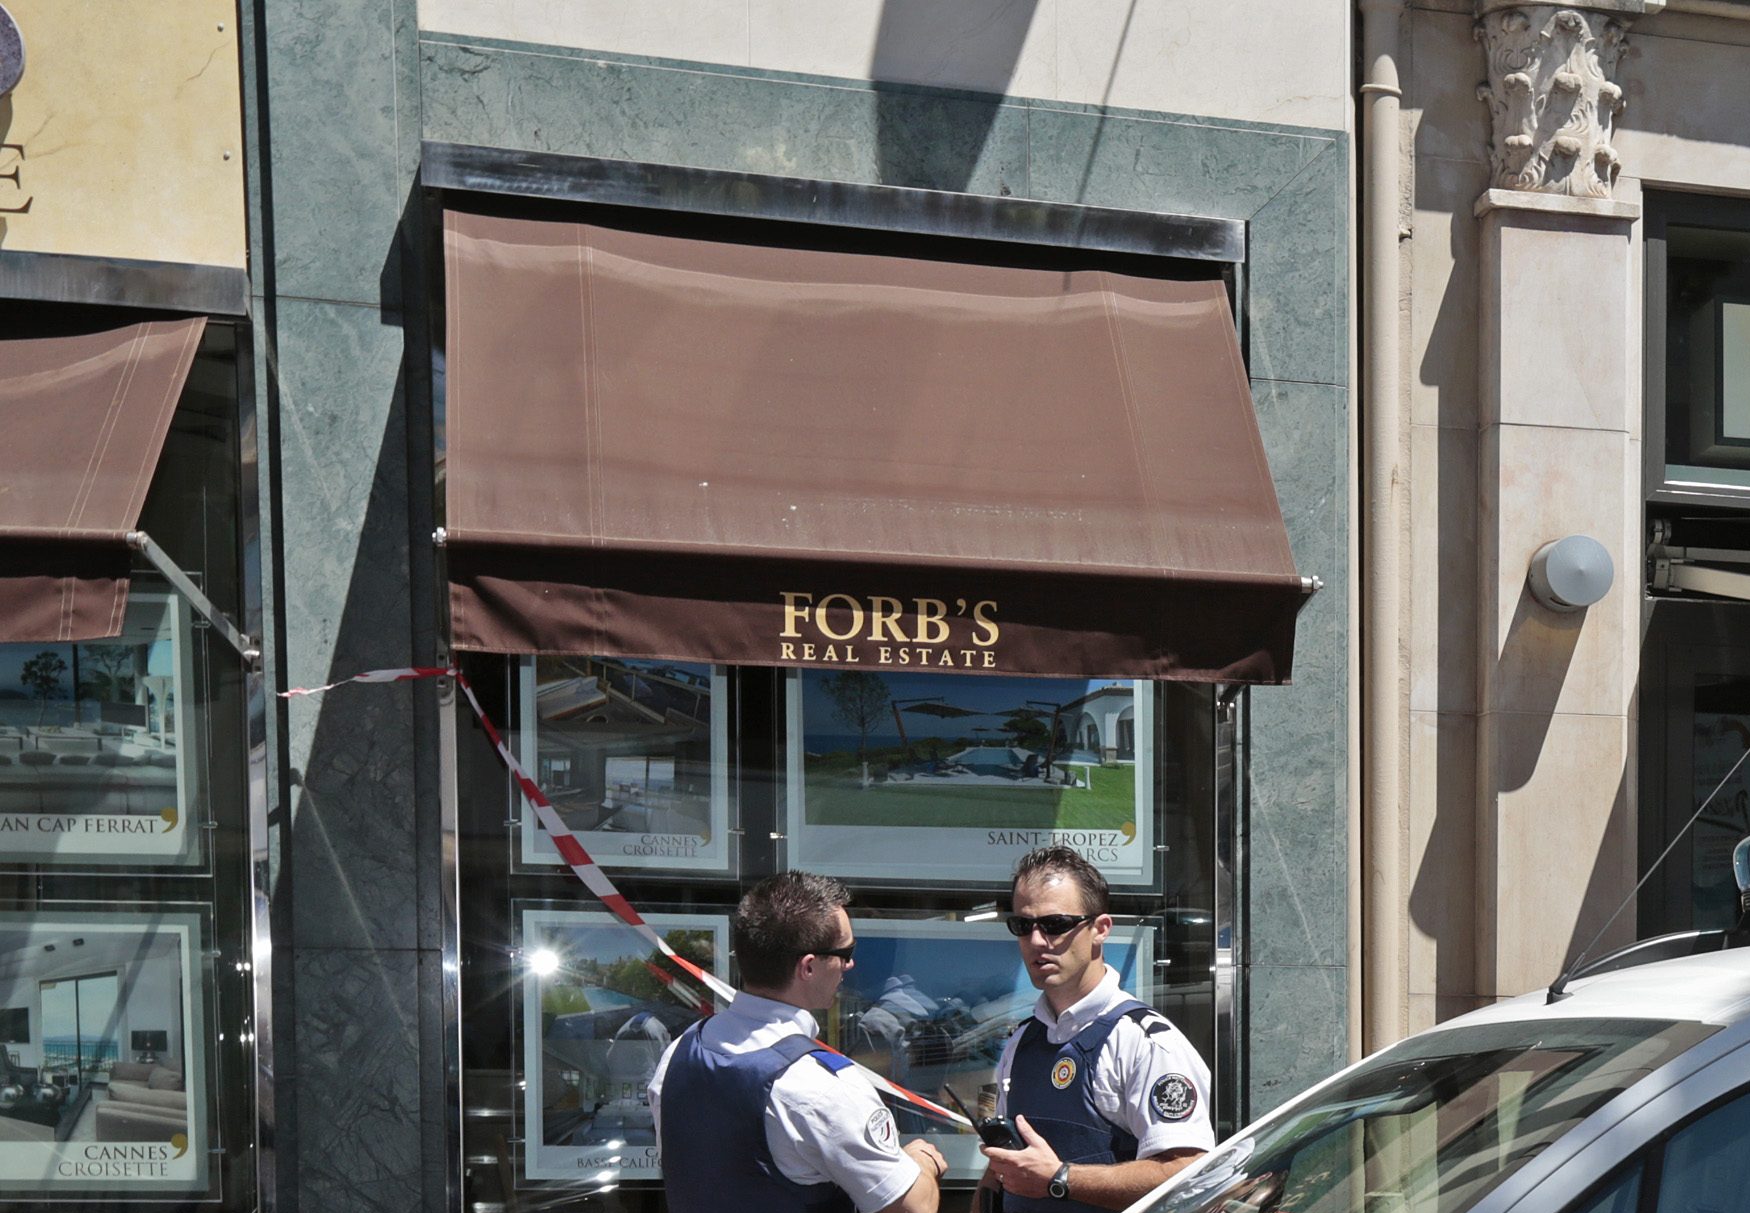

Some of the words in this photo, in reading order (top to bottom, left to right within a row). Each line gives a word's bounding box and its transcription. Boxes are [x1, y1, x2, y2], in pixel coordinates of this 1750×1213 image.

[780, 591, 1000, 646] FORB'S
[780, 642, 860, 663] REAL
[878, 646, 997, 668] ESTATE
[0, 817, 29, 831] AN
[37, 818, 76, 832] CAP
[85, 818, 158, 834] FERRAT
[641, 834, 698, 846] CANNES
[987, 831, 1118, 847] SAINT-TROPEZ
[622, 844, 697, 857] CROISETTE
[84, 1145, 168, 1161] CANNES
[58, 1161, 168, 1177] CROISETTE
